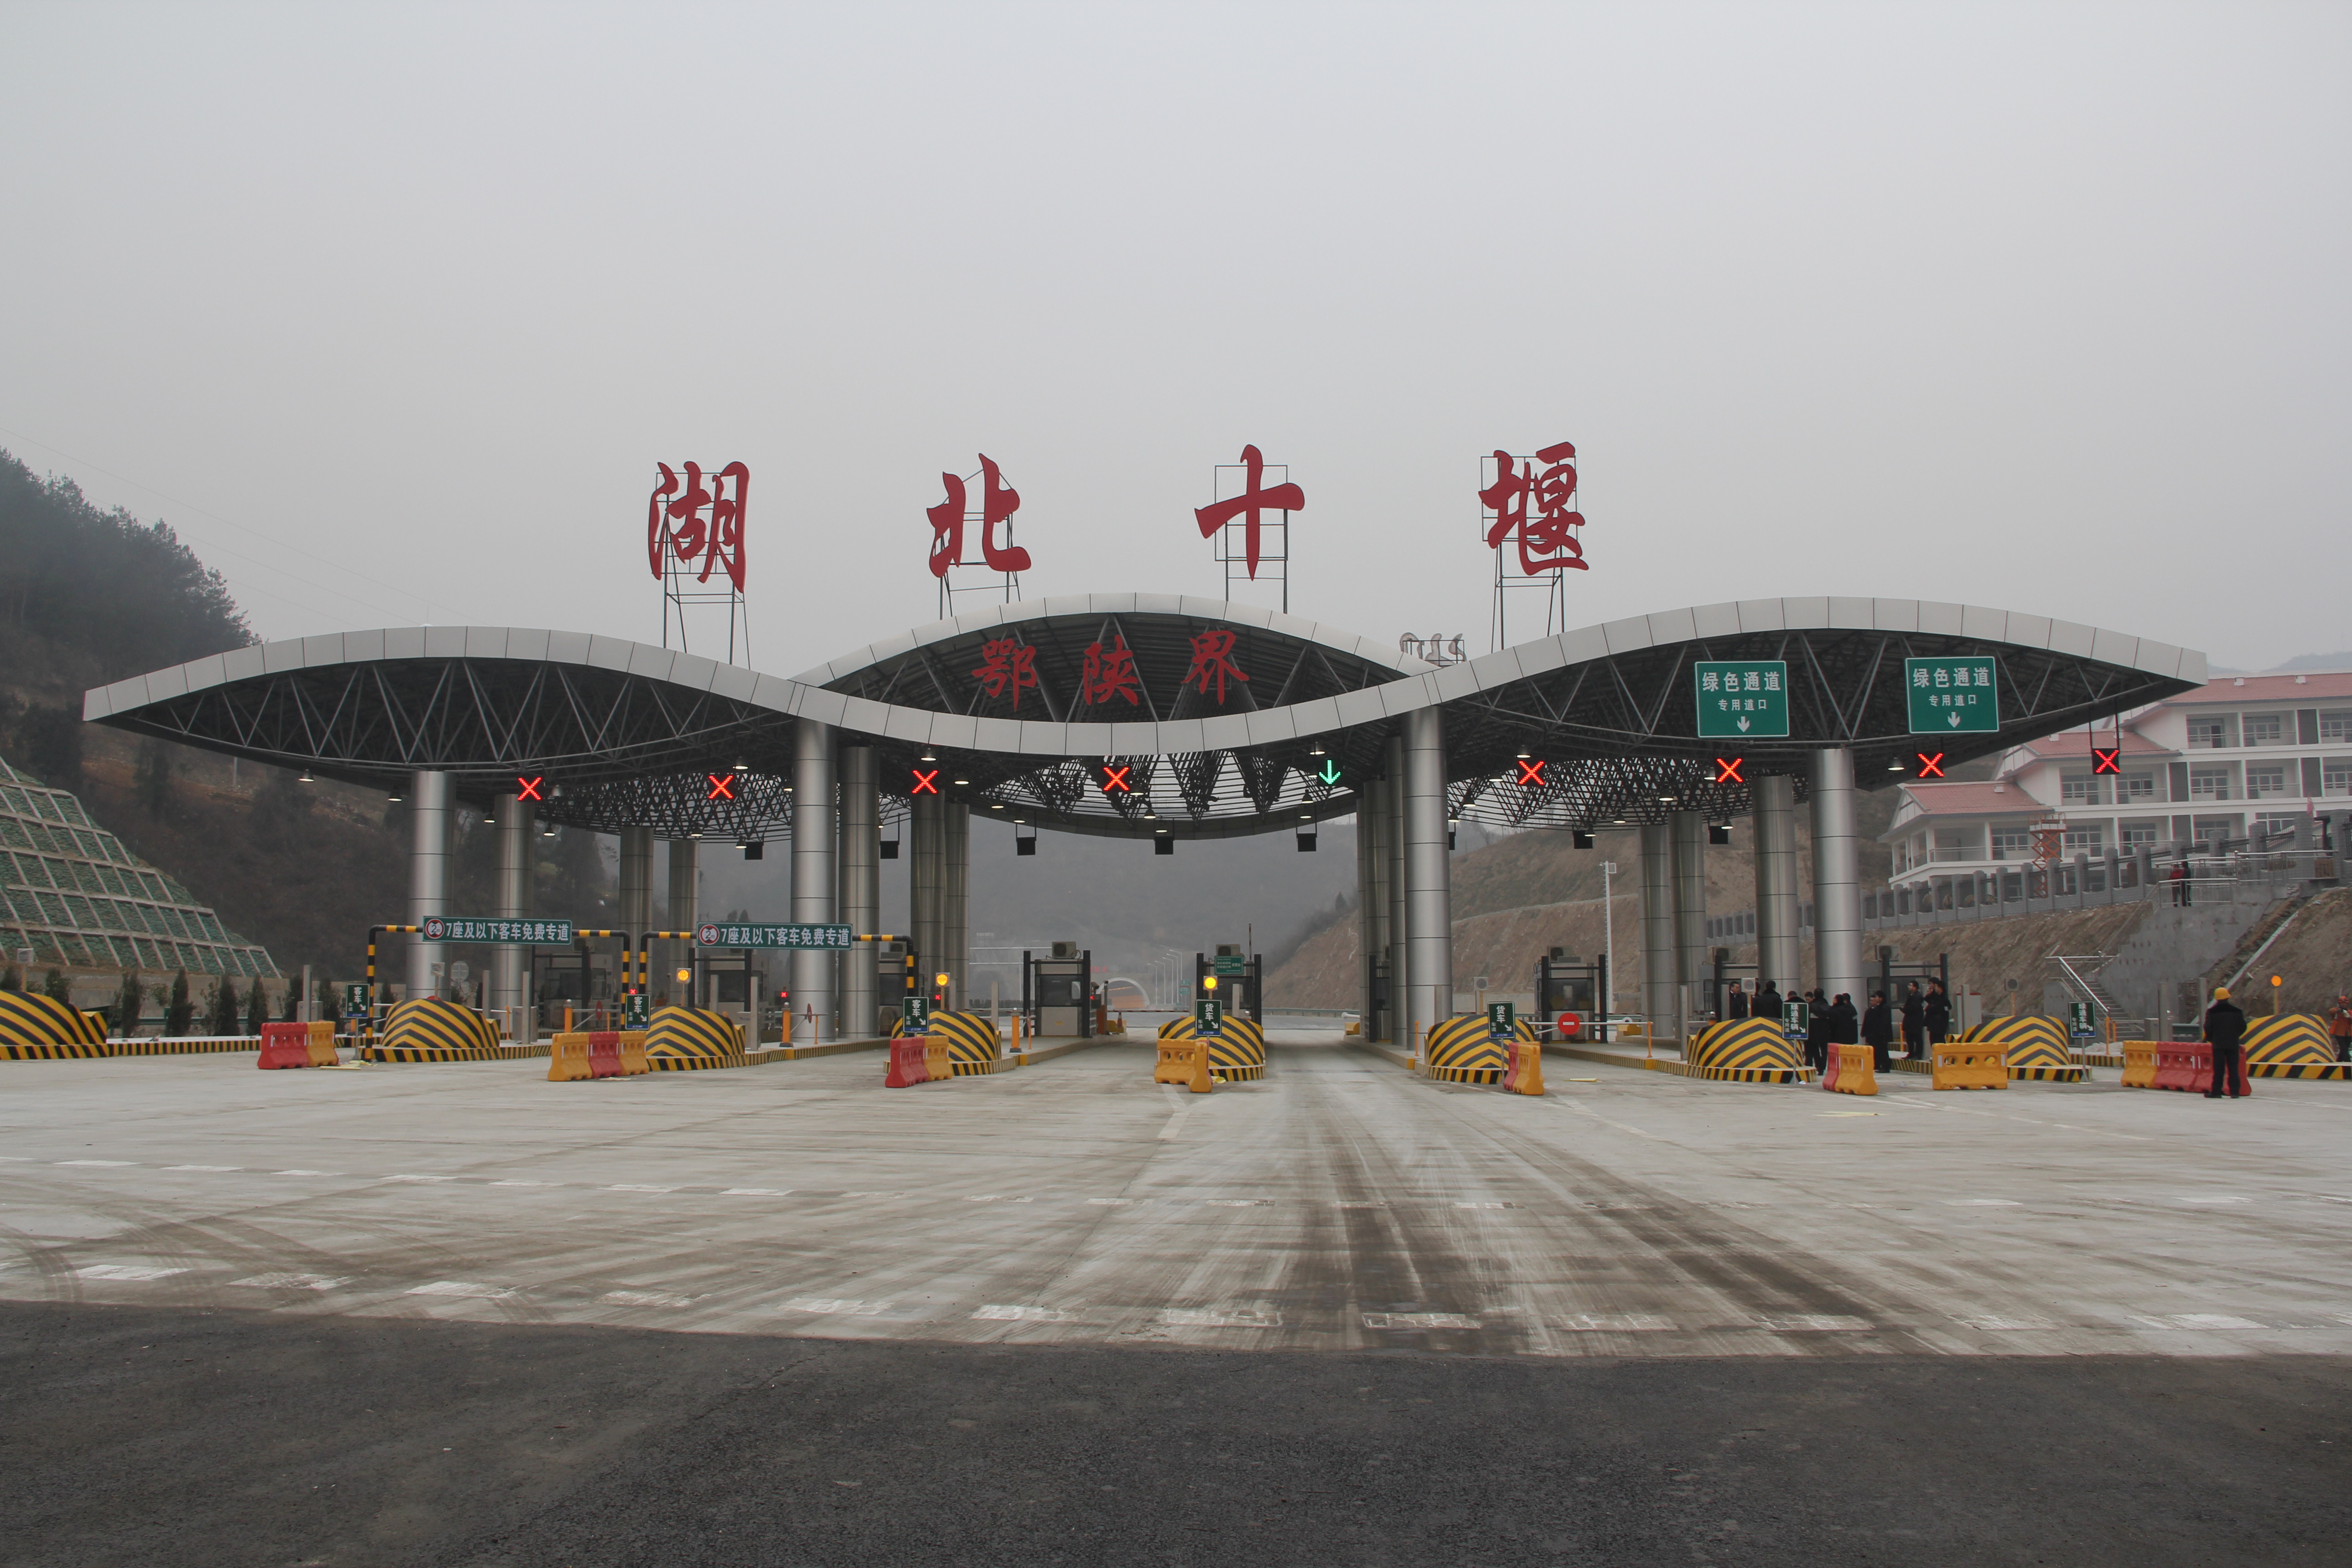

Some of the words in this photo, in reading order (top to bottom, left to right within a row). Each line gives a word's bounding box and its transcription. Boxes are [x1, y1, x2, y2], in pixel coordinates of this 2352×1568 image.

[649, 443, 1588, 593] 湖北十堰
[971, 630, 1250, 711] 鄂陕界
[1913, 667, 1990, 688] 绿色通道
[1702, 671, 1781, 692] 绿色通道
[1718, 699, 1767, 711] 专用道口
[1929, 694, 1977, 707] 专用道口
[446, 921, 569, 941] 7座及以下客车免费专道
[706, 930, 715, 939] 2m
[721, 924, 849, 946] 7座及以下客车免费专道
[354, 986, 362, 1003] 客车
[634, 996, 642, 1014] 客车
[912, 1000, 921, 1017] 客车
[1205, 1003, 1214, 1021] 货车
[1496, 1005, 1505, 1023] 货车
